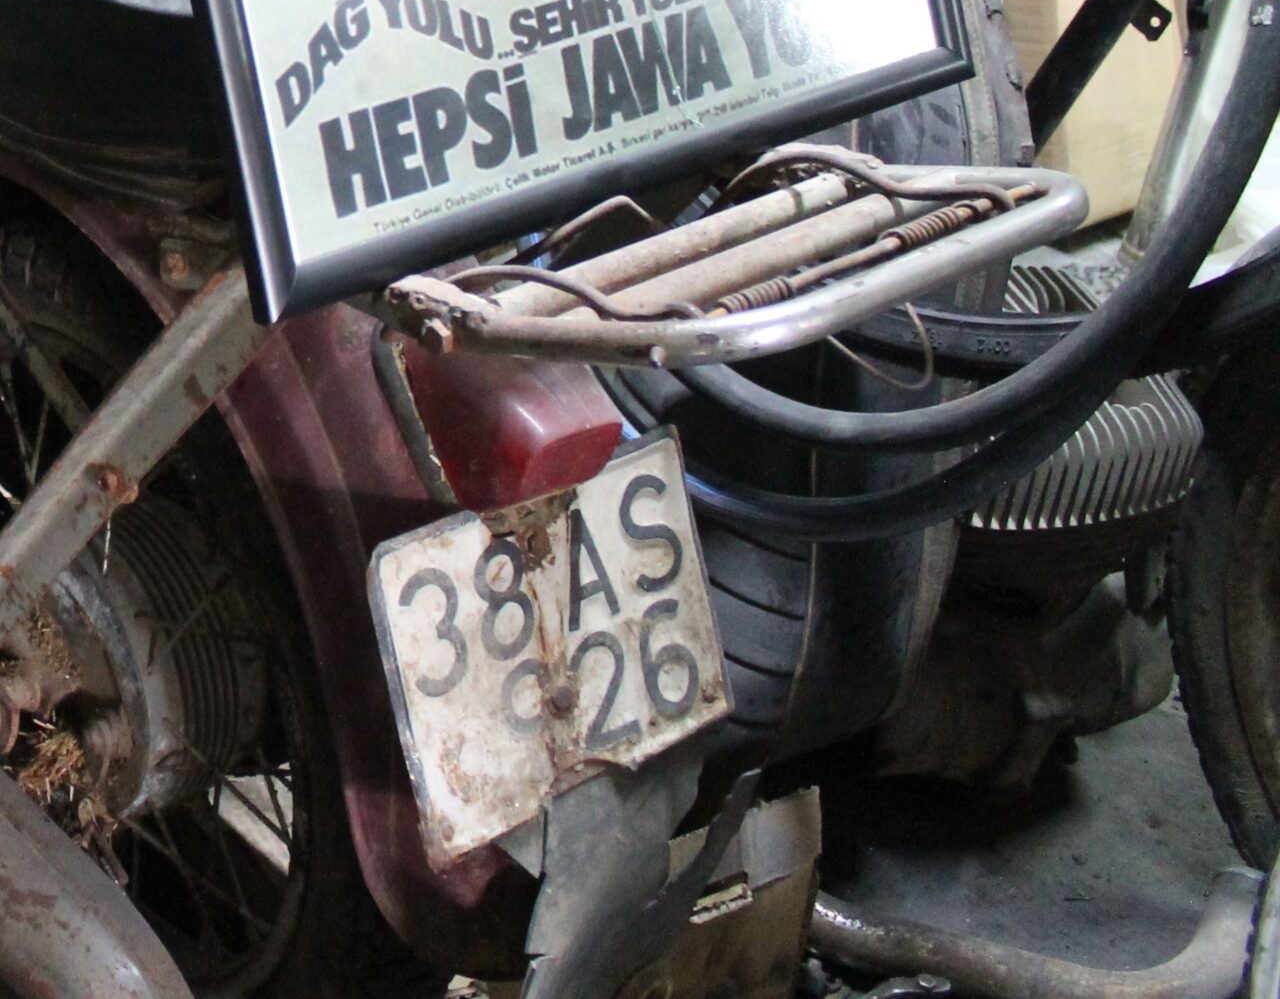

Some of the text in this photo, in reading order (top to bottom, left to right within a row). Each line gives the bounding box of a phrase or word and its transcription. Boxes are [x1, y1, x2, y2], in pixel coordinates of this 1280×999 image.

[560, 2, 734, 142] JAWA
[398, 473, 684, 698] 38 AS
